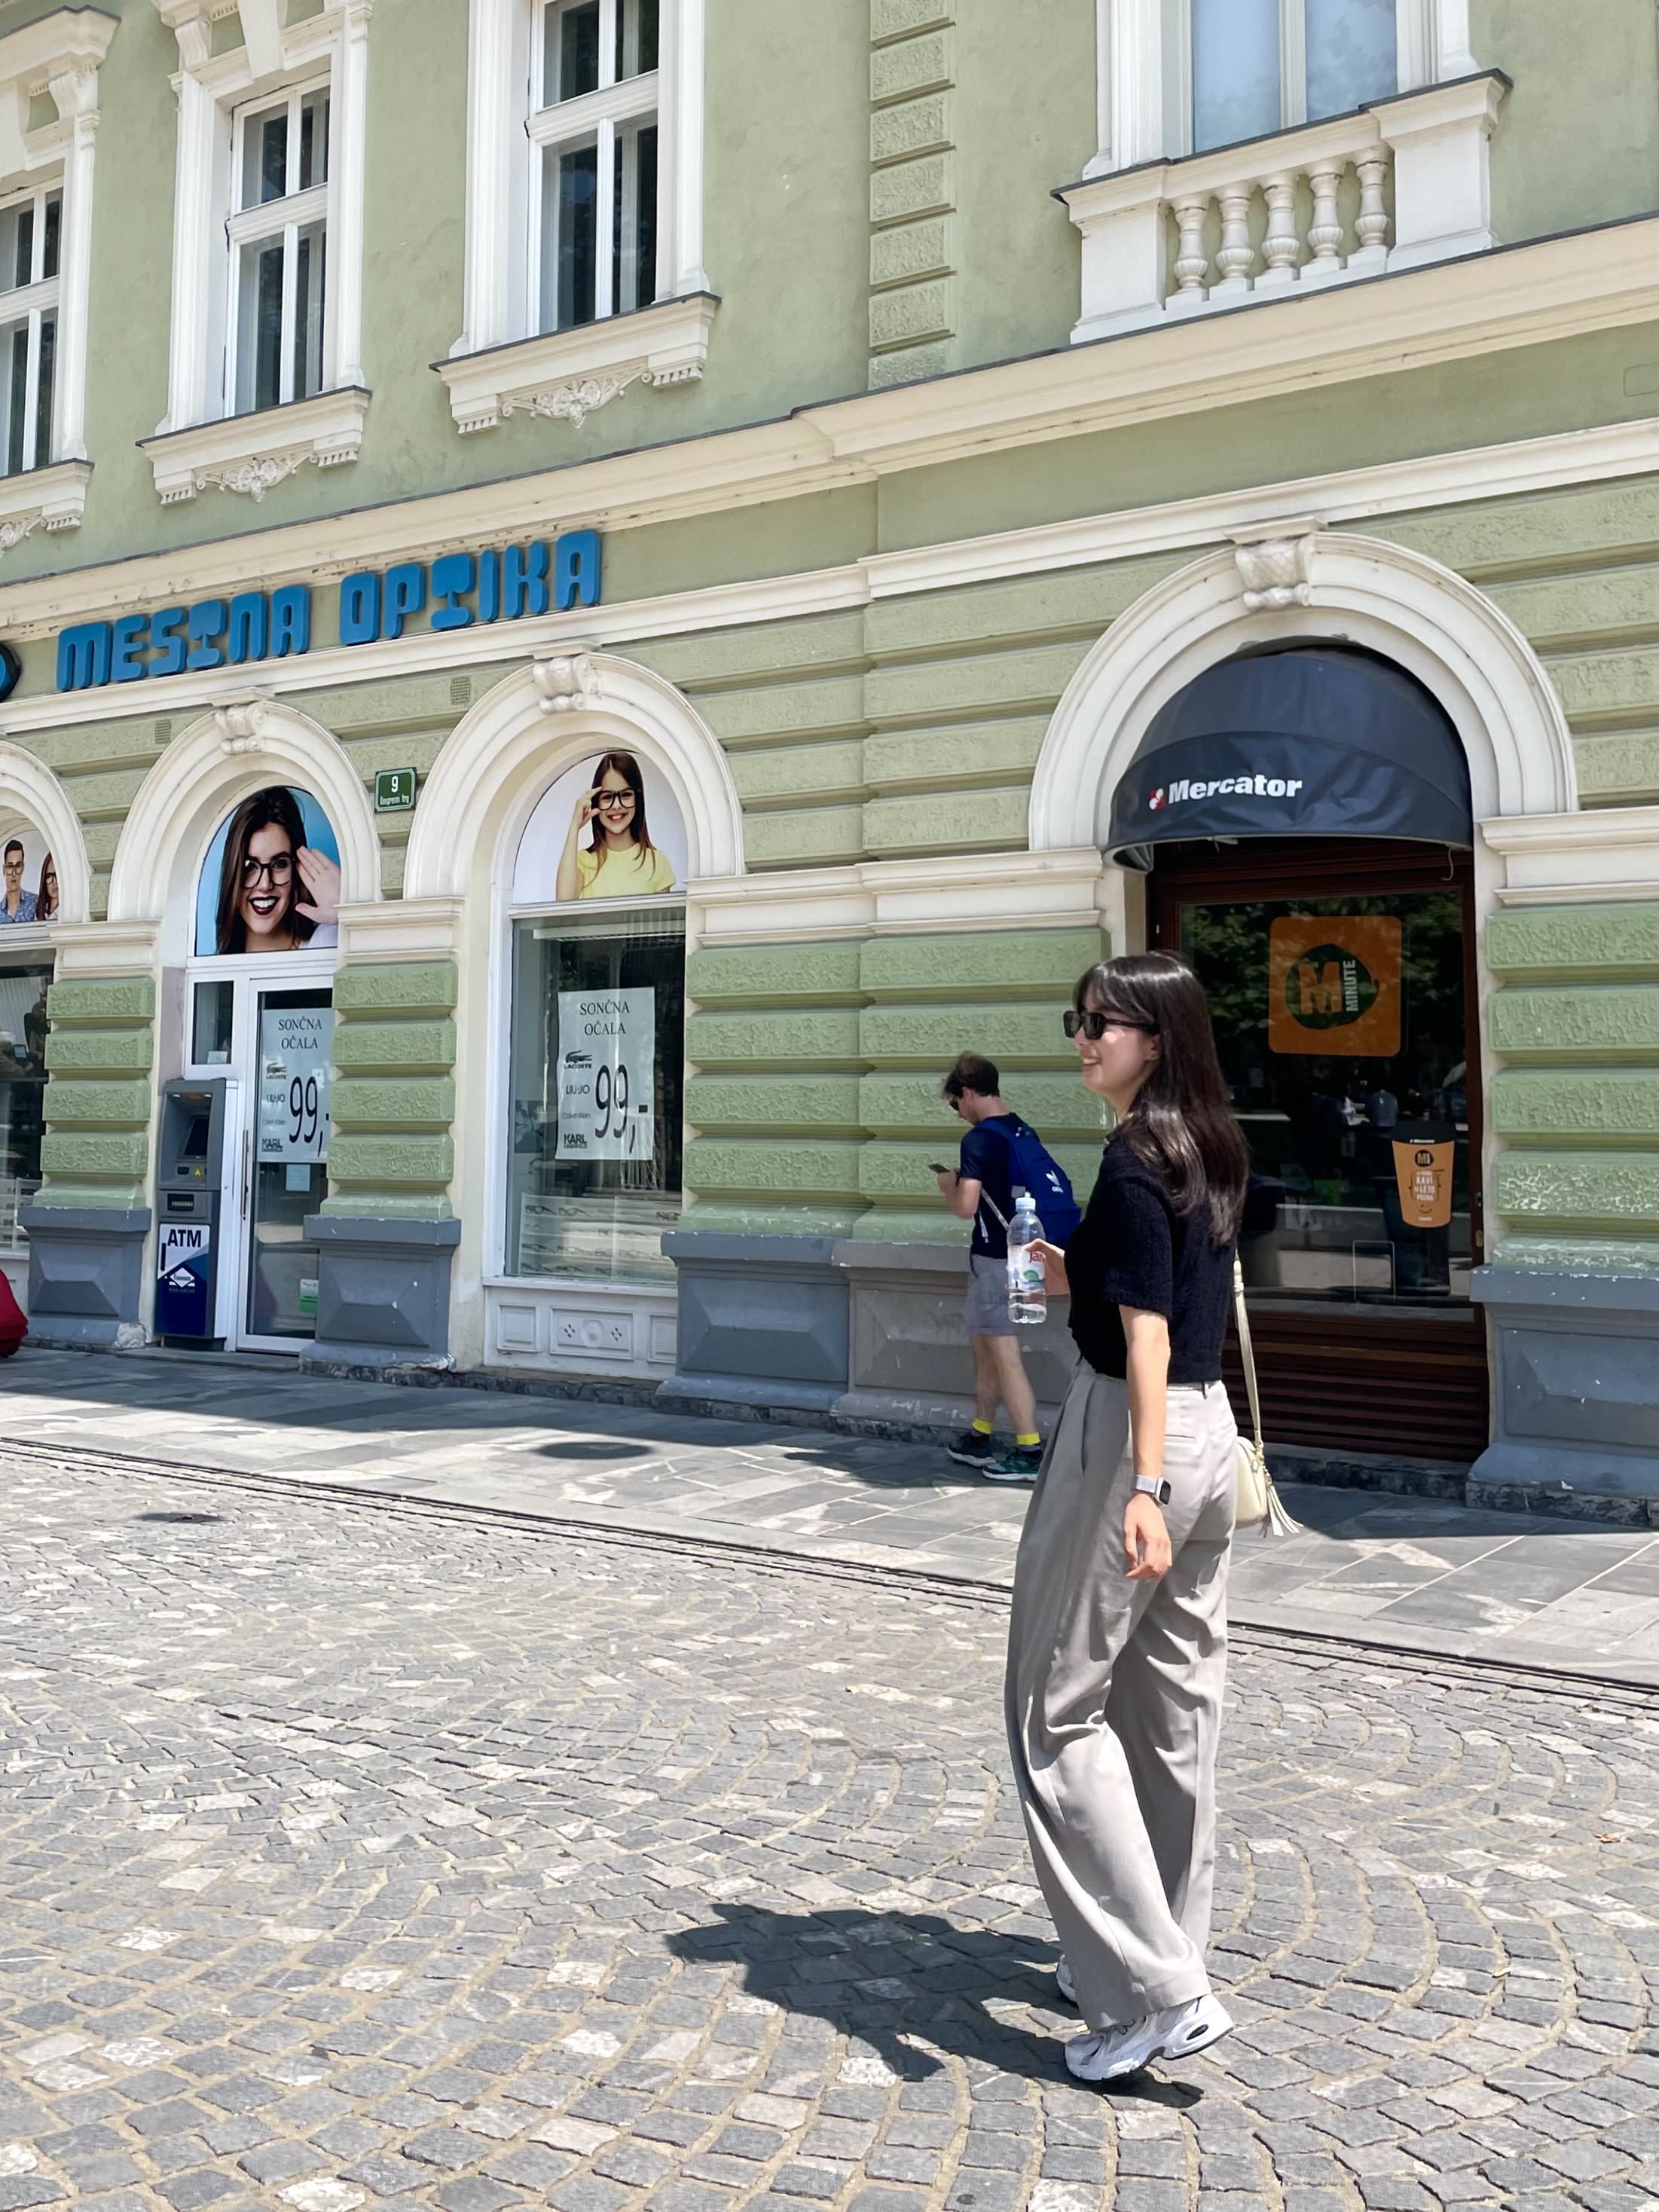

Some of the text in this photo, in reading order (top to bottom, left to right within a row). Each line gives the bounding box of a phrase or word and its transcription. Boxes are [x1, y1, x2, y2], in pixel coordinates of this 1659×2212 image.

[339, 530, 600, 646] OPTIKA
[391, 775, 399, 793] 9
[1168, 774, 1303, 804] Mercator
[1343, 959, 1359, 1012] MINUTE
[579, 999, 630, 1016] SONČNA
[278, 1016, 322, 1031] SONČNA
[584, 1021, 626, 1036] OČALA
[281, 1035, 318, 1049] OČALA
[261, 1138, 283, 1147] KARL
[564, 1133, 587, 1144] KARL
[1416, 1176, 1433, 1184] KAVI
[167, 1229, 201, 1248] ATM
